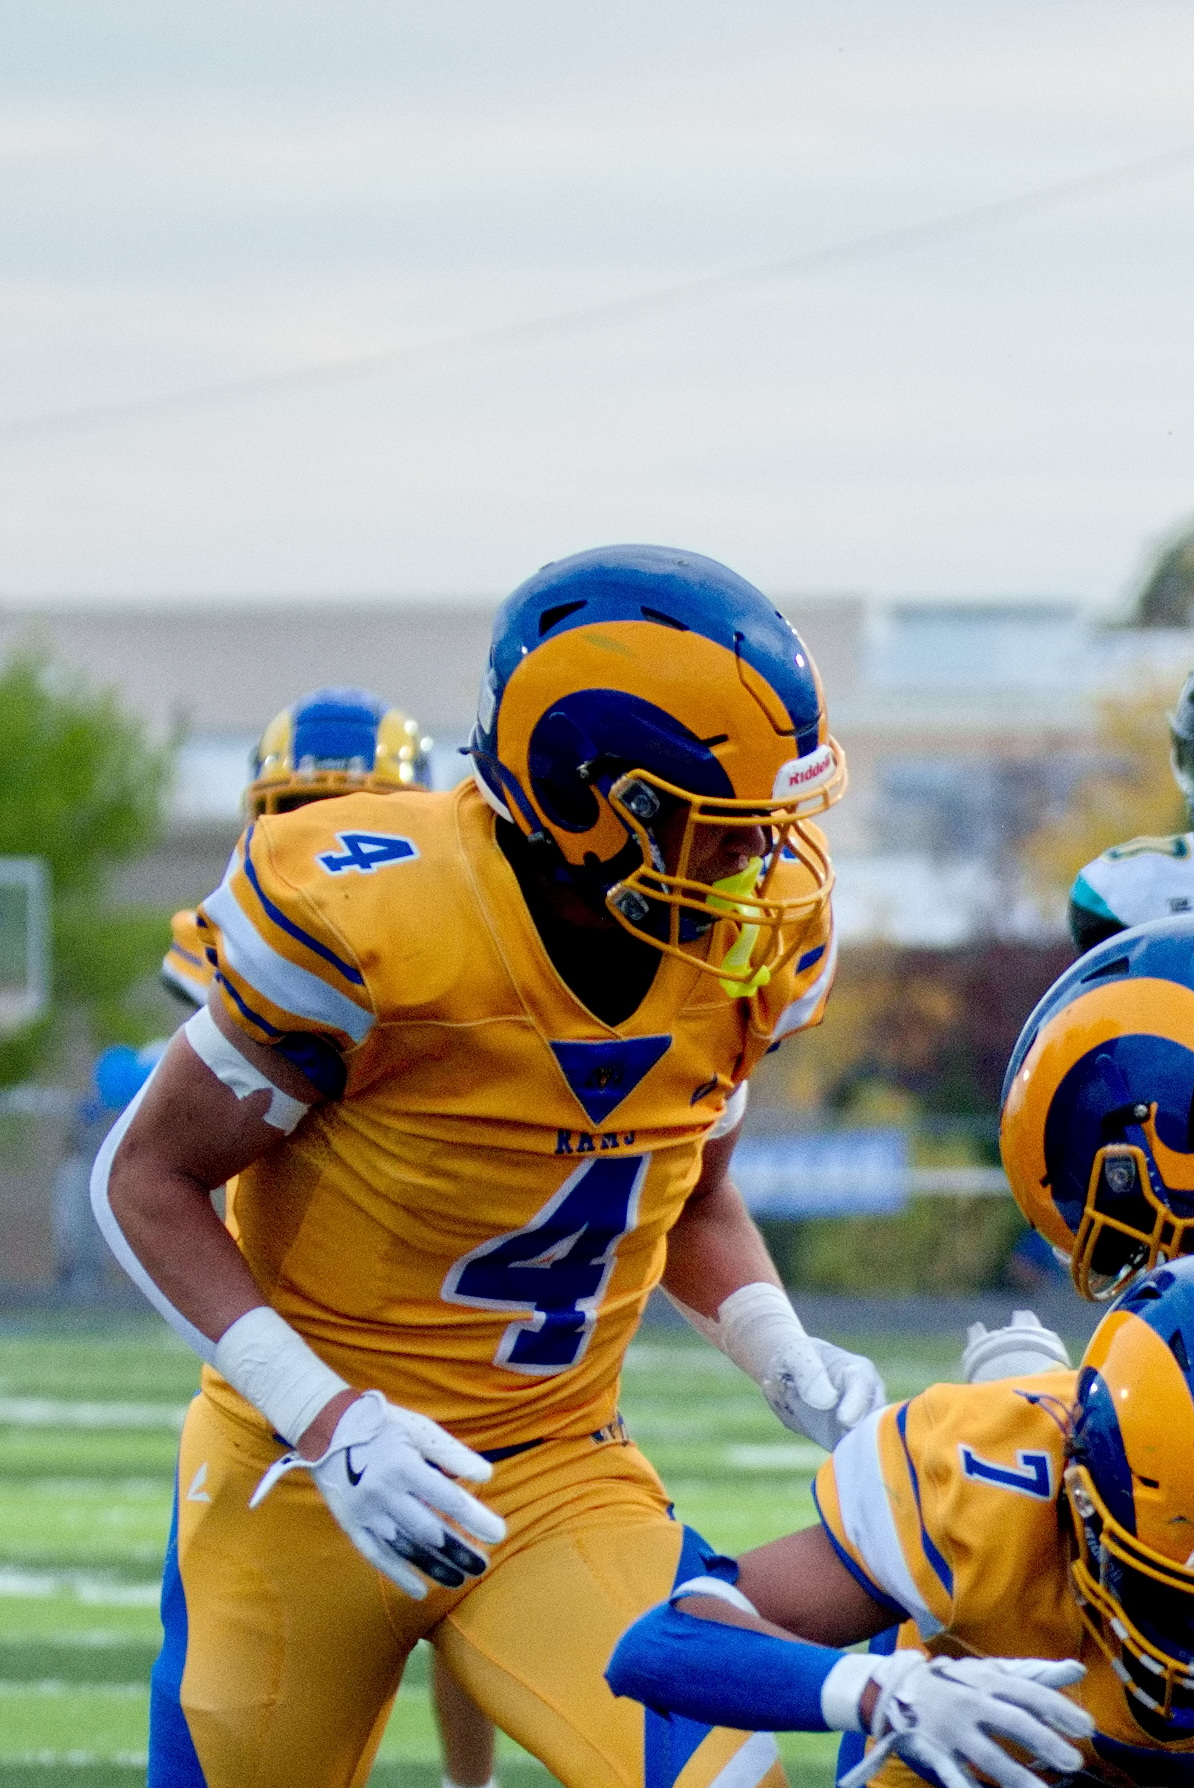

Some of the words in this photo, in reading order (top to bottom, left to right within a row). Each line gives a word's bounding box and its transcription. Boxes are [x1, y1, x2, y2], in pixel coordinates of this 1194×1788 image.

[314, 828, 421, 877] 4
[440, 1150, 653, 1377] 4
[957, 1442, 1055, 1502] 7
